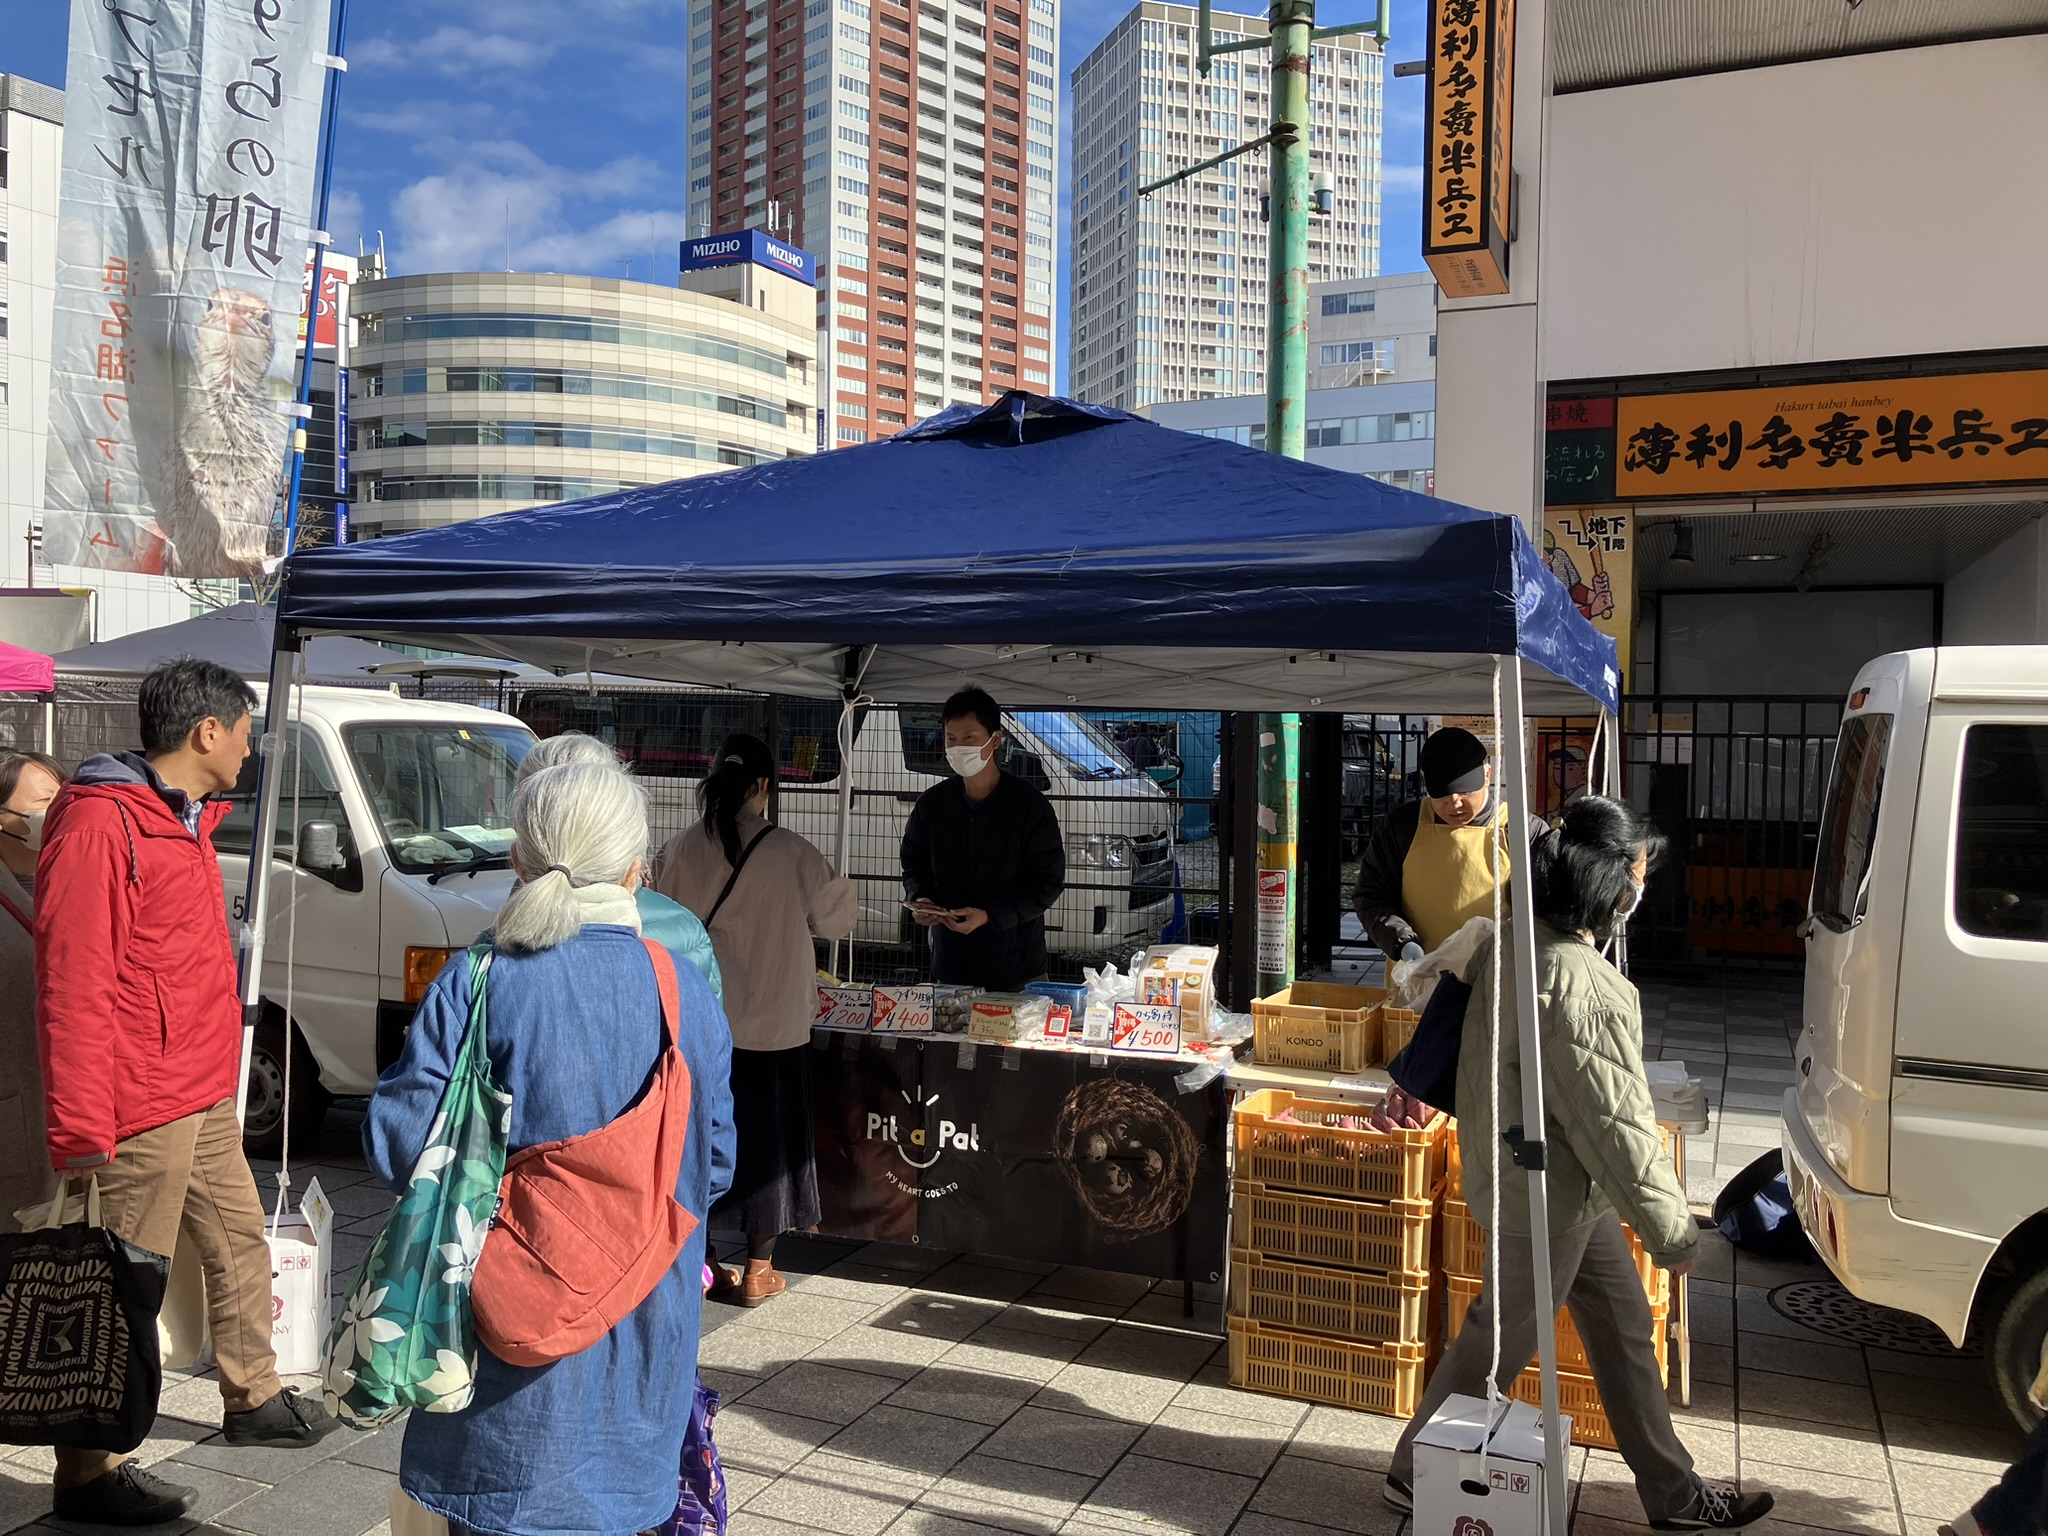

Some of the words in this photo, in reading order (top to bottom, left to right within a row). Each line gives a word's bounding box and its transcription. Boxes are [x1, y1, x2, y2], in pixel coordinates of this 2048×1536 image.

[692, 239, 740, 257] MIZUHO
[767, 242, 803, 268] MIZUHO
[1774, 399, 1814, 412] Hakuri
[1817, 397, 1847, 410] tabai
[1850, 395, 1894, 409] hanbey
[1588, 516, 1626, 535] 地下
[1602, 536, 1625, 551] 1階
[1286, 1036, 1323, 1047] KONDO
[867, 1112, 898, 1142] Pit
[910, 1129, 925, 1145] a
[939, 1120, 979, 1151] Pat
[885, 1170, 898, 1184] MY
[898, 1181, 922, 1197] HEART
[925, 1186, 946, 1198] GOES
[946, 1181, 959, 1193] TO
[9, 1258, 113, 1283] KINOKUNIYA
[22, 1280, 102, 1300] KINOKUNIYA
[38, 1300, 86, 1315] KINOKUNIYA
[81, 1299, 95, 1357] KINOKUNIYA
[94, 1283, 112, 1372] KINOKUNIYA
[2, 1296, 34, 1388] KINOKUNIYA
[26, 1308, 47, 1369] KINOKUNIYA
[34, 1355, 88, 1371] KINOKUNIYA
[16, 1370, 105, 1389] KINOKUNIYA
